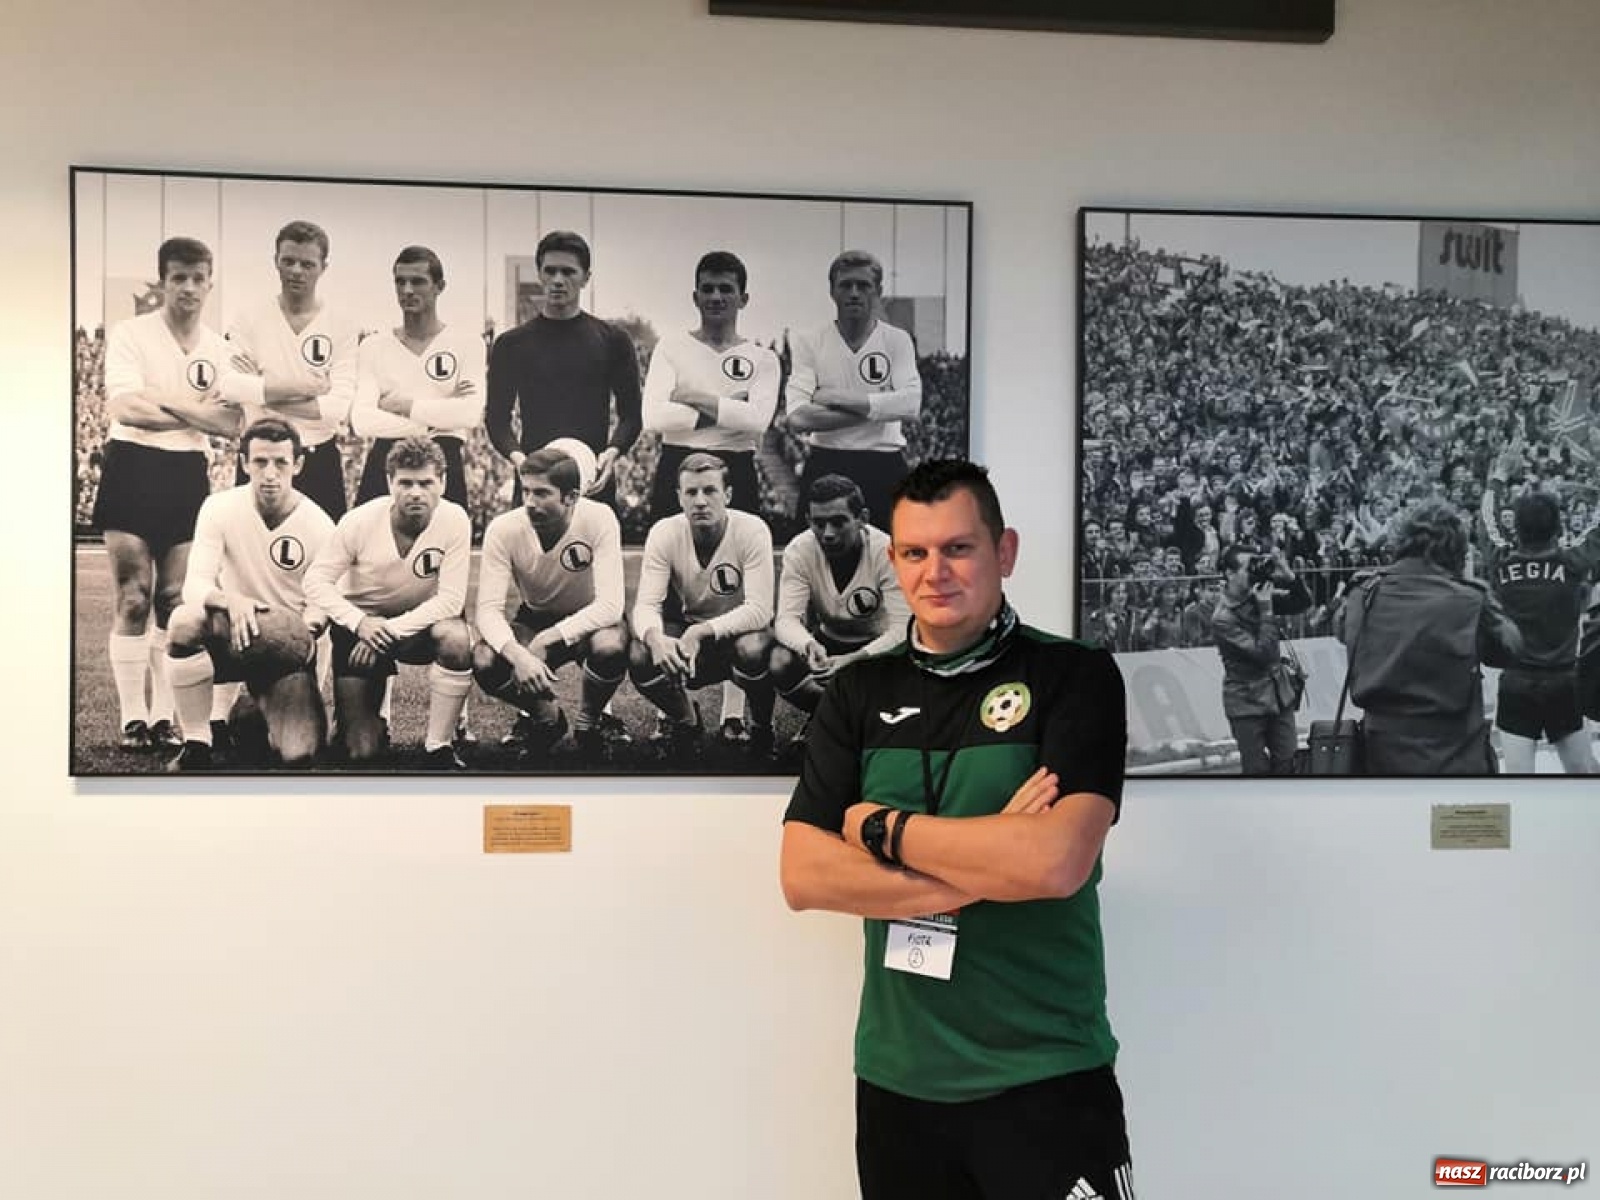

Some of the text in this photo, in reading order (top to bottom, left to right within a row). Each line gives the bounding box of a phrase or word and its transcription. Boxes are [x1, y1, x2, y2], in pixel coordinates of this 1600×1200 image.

[313, 339, 325, 362] L
[197, 363, 207, 387] L
[436, 356, 448, 376] L
[732, 359, 746, 377] L
[869, 357, 883, 379] L
[280, 539, 295, 565] L
[569, 548, 588, 569] L
[423, 553, 439, 575] L
[1499, 562, 1566, 585] LEGIA
[717, 569, 736, 592] L
[854, 592, 874, 613] L
